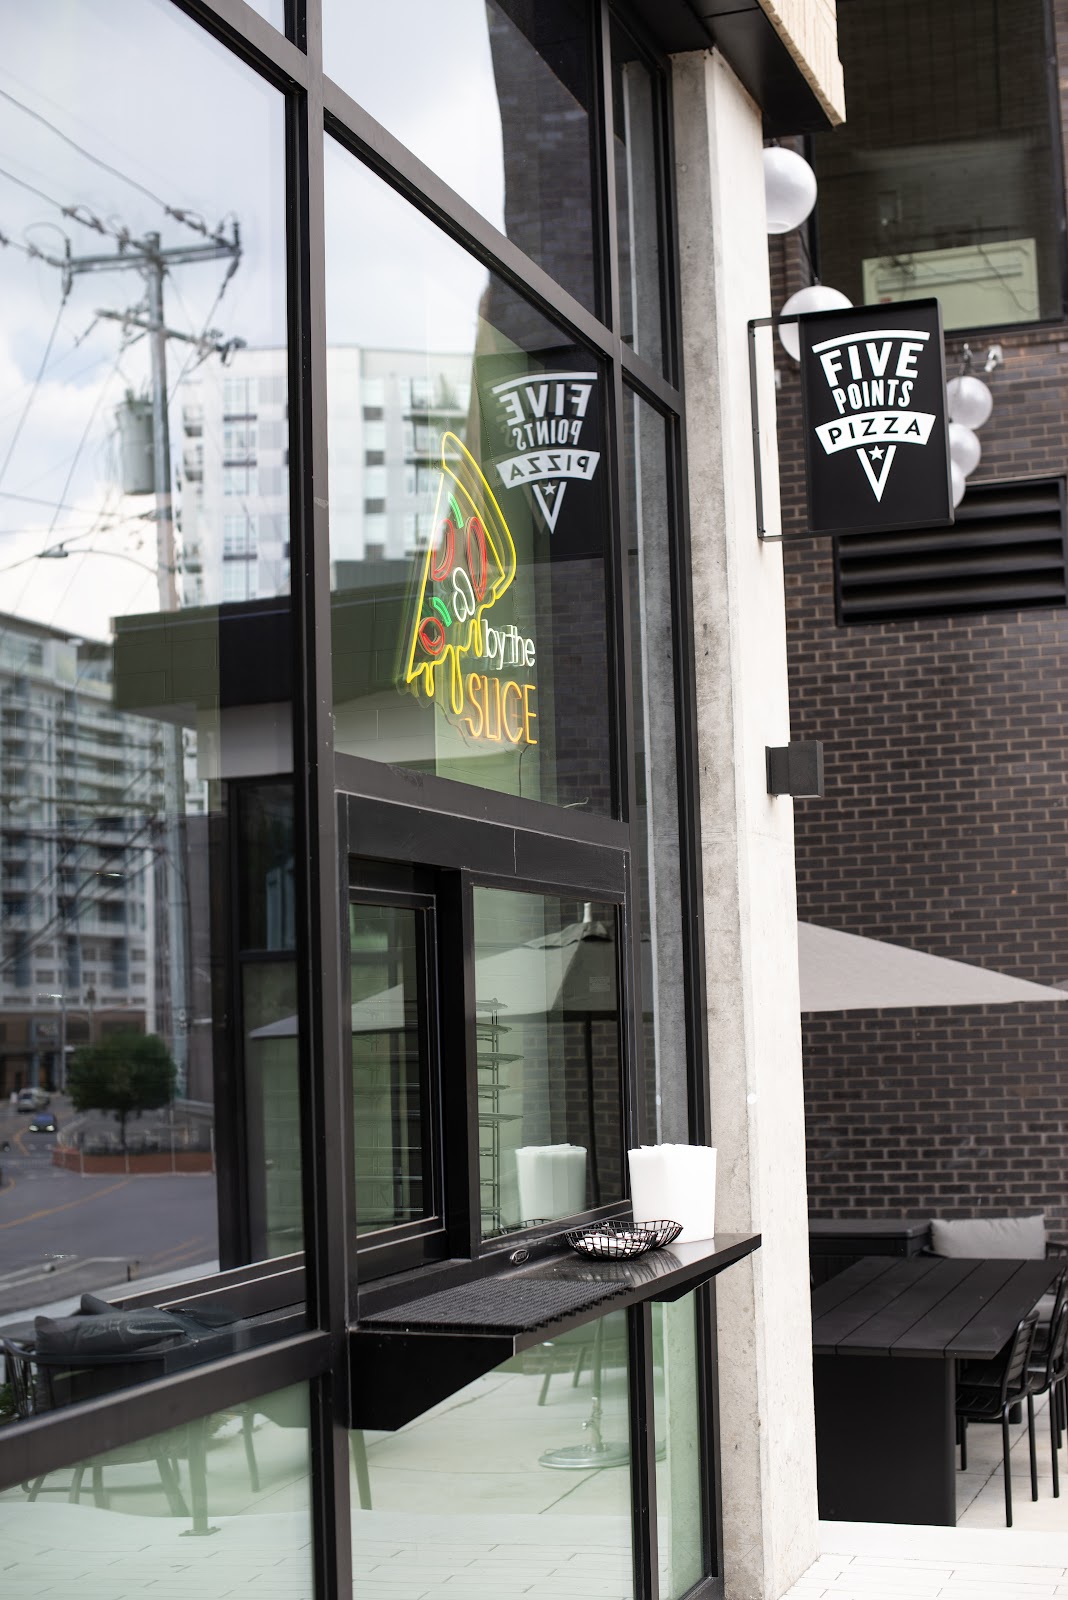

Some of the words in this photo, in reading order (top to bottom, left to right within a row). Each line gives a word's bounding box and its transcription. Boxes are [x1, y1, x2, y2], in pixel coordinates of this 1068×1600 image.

[819, 341, 924, 388] FIVE
[831, 379, 914, 415] POINTS
[827, 417, 921, 445] PIZZA
[480, 619, 505, 670] by
[504, 624, 536, 667] the
[463, 672, 538, 745] SLICE
